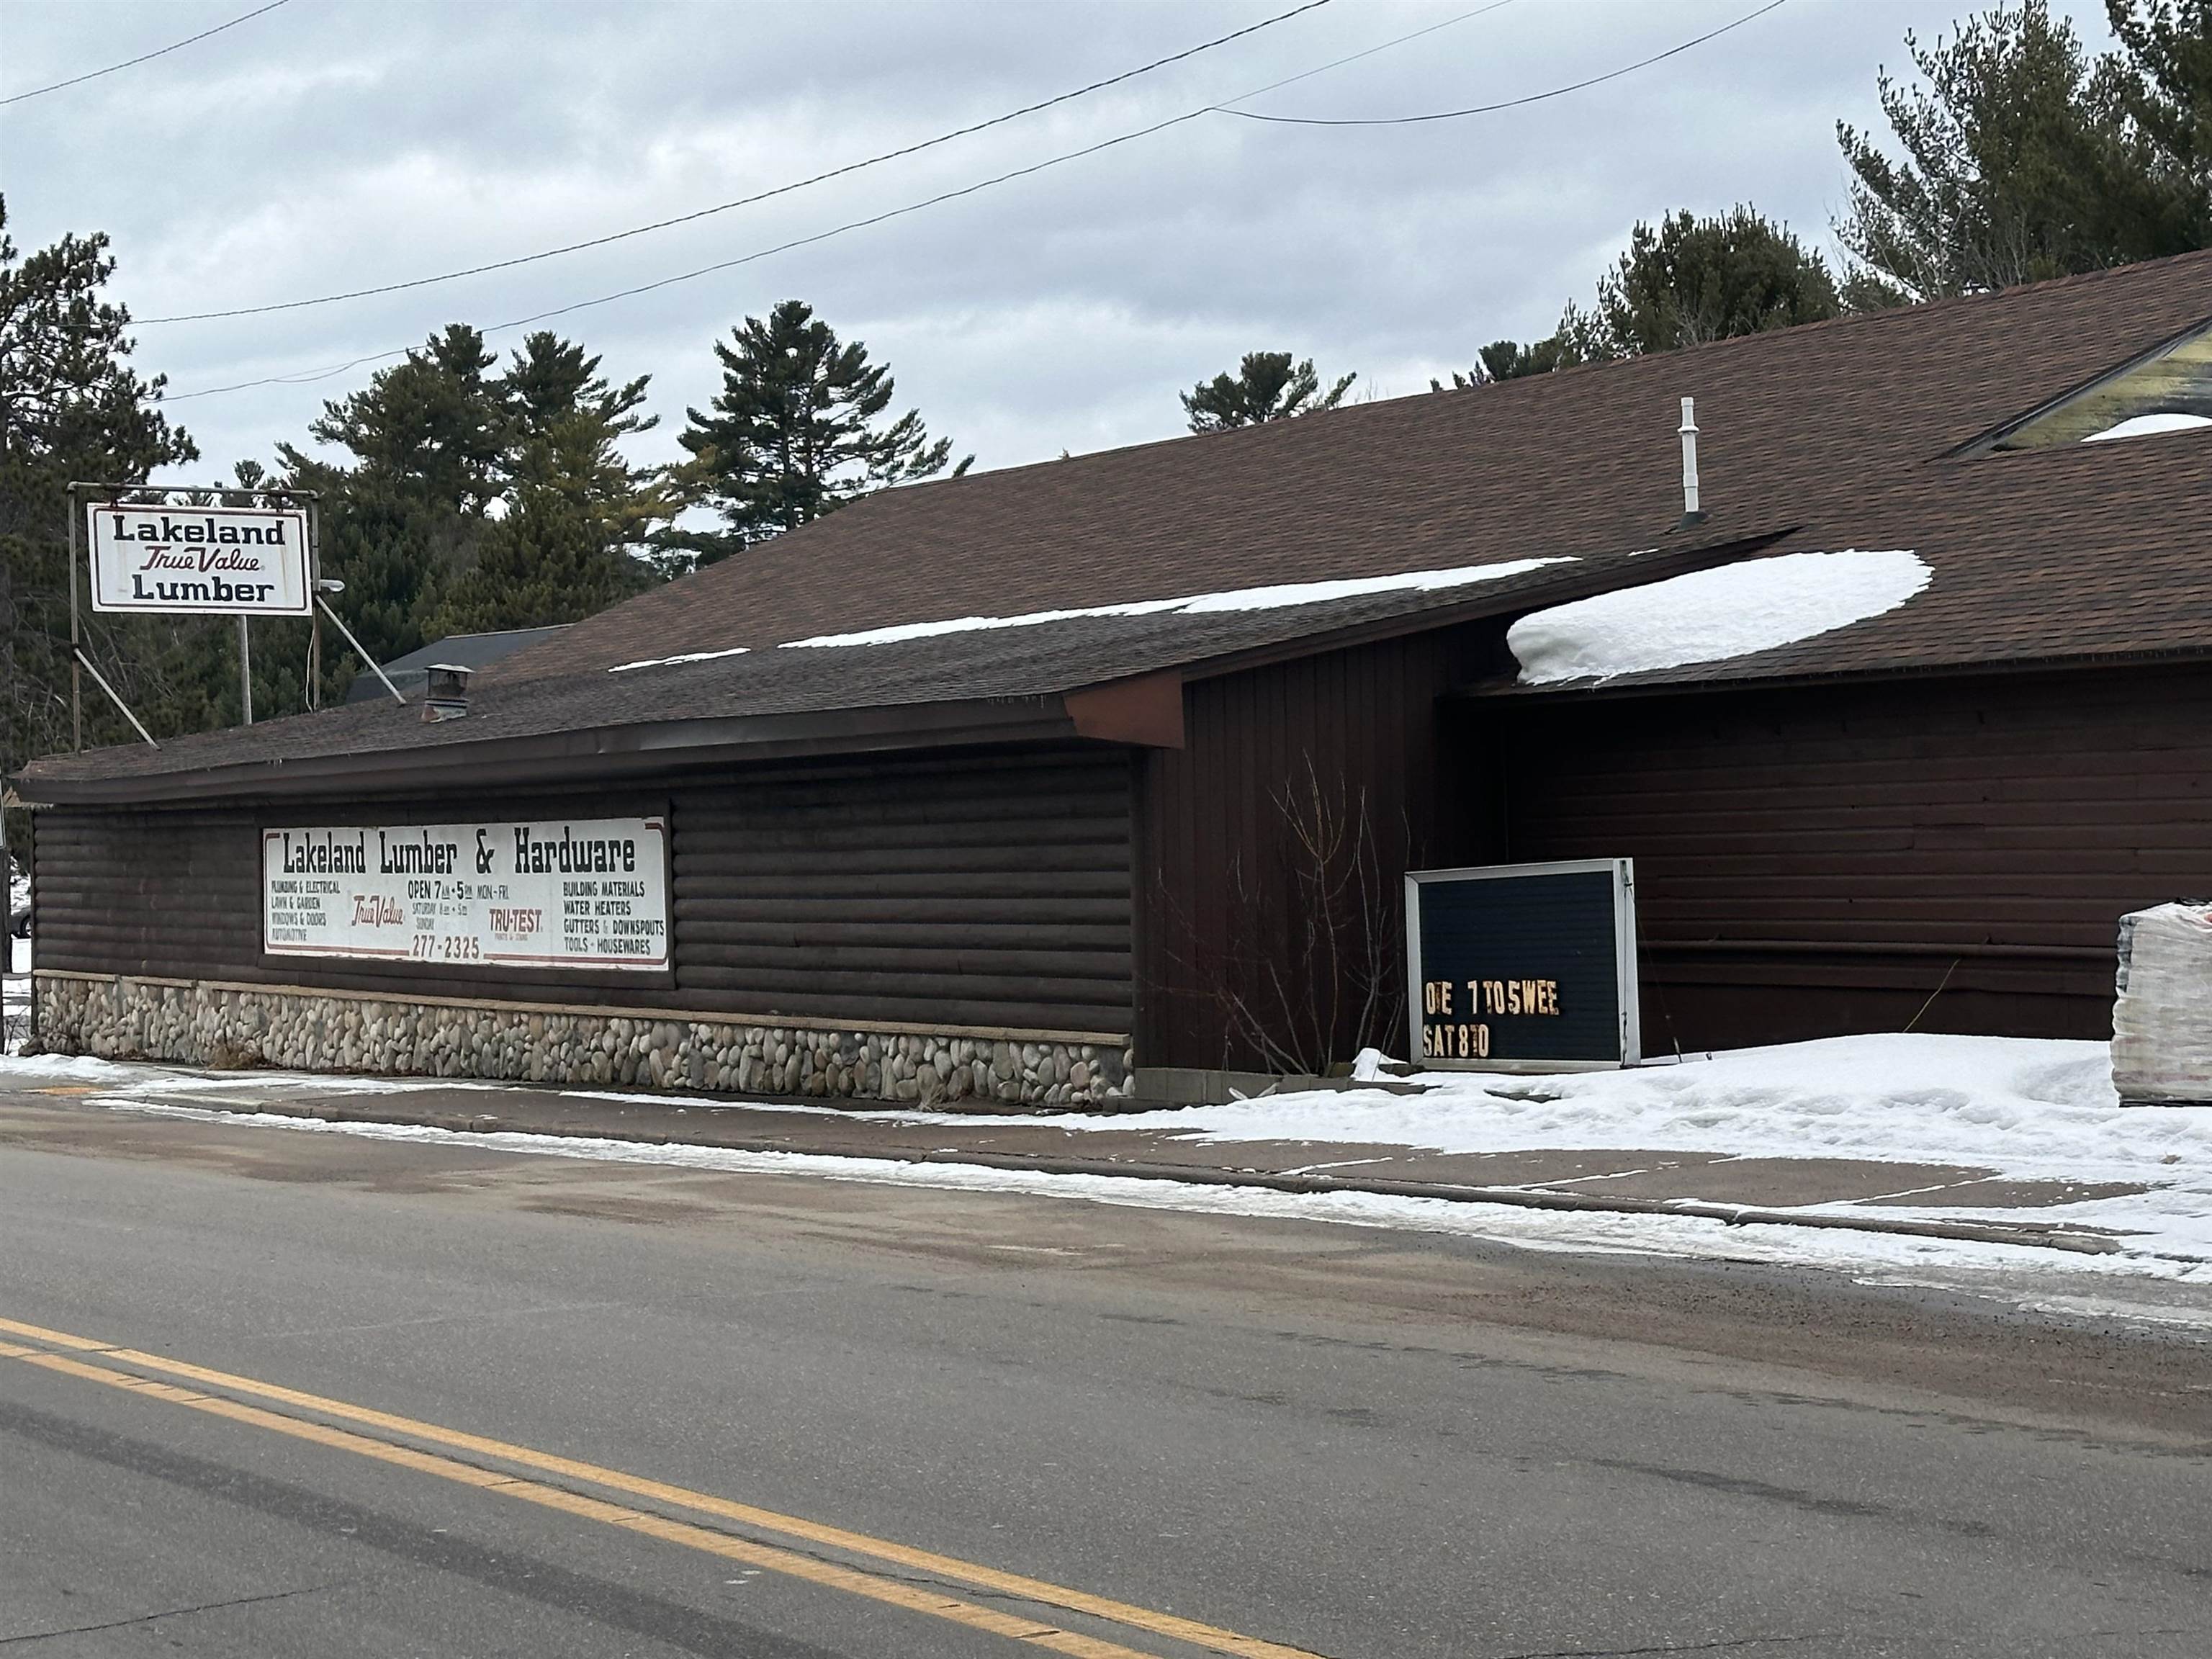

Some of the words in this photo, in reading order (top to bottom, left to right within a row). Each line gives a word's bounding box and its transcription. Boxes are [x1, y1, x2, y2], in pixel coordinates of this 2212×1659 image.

[112, 515, 285, 545] Lakeland
[132, 574, 274, 602] Lumber
[283, 832, 366, 873] Lakeland
[379, 830, 457, 874] Lumber
[475, 828, 495, 874] &
[513, 826, 635, 873] Hardware
[408, 880, 431, 899] OPEN
[563, 881, 598, 897] BUILDING
[601, 881, 645, 897] MATERIALS
[564, 900, 590, 915] WATER
[595, 900, 631, 915] HEATERS
[564, 918, 599, 935] GUTTERS
[613, 920, 664, 936] DOWNSPOUTS
[565, 937, 588, 952] TOOLS
[597, 938, 651, 956] HOUSEWARES
